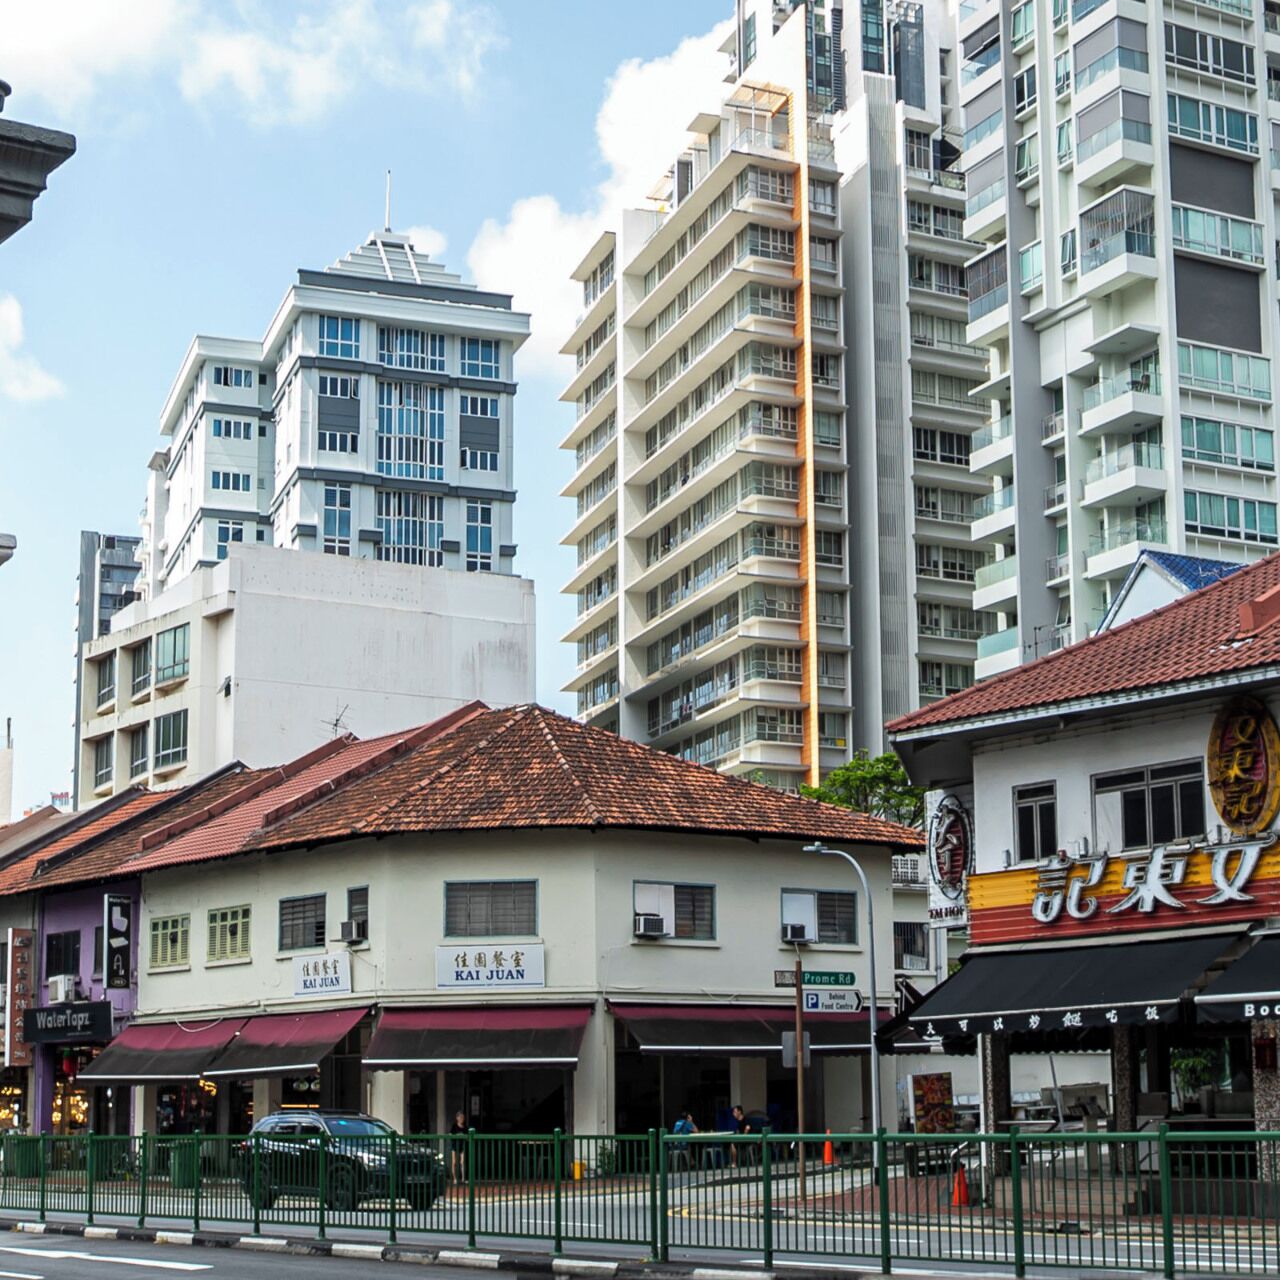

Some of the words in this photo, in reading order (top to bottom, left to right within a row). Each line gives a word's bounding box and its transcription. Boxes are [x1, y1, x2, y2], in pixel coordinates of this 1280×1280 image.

[455, 970, 480, 981] KAI
[486, 969, 525, 980] JUAN
[839, 973, 851, 984] Rd
[303, 978, 317, 989] KAI
[319, 976, 340, 987] JUAN
